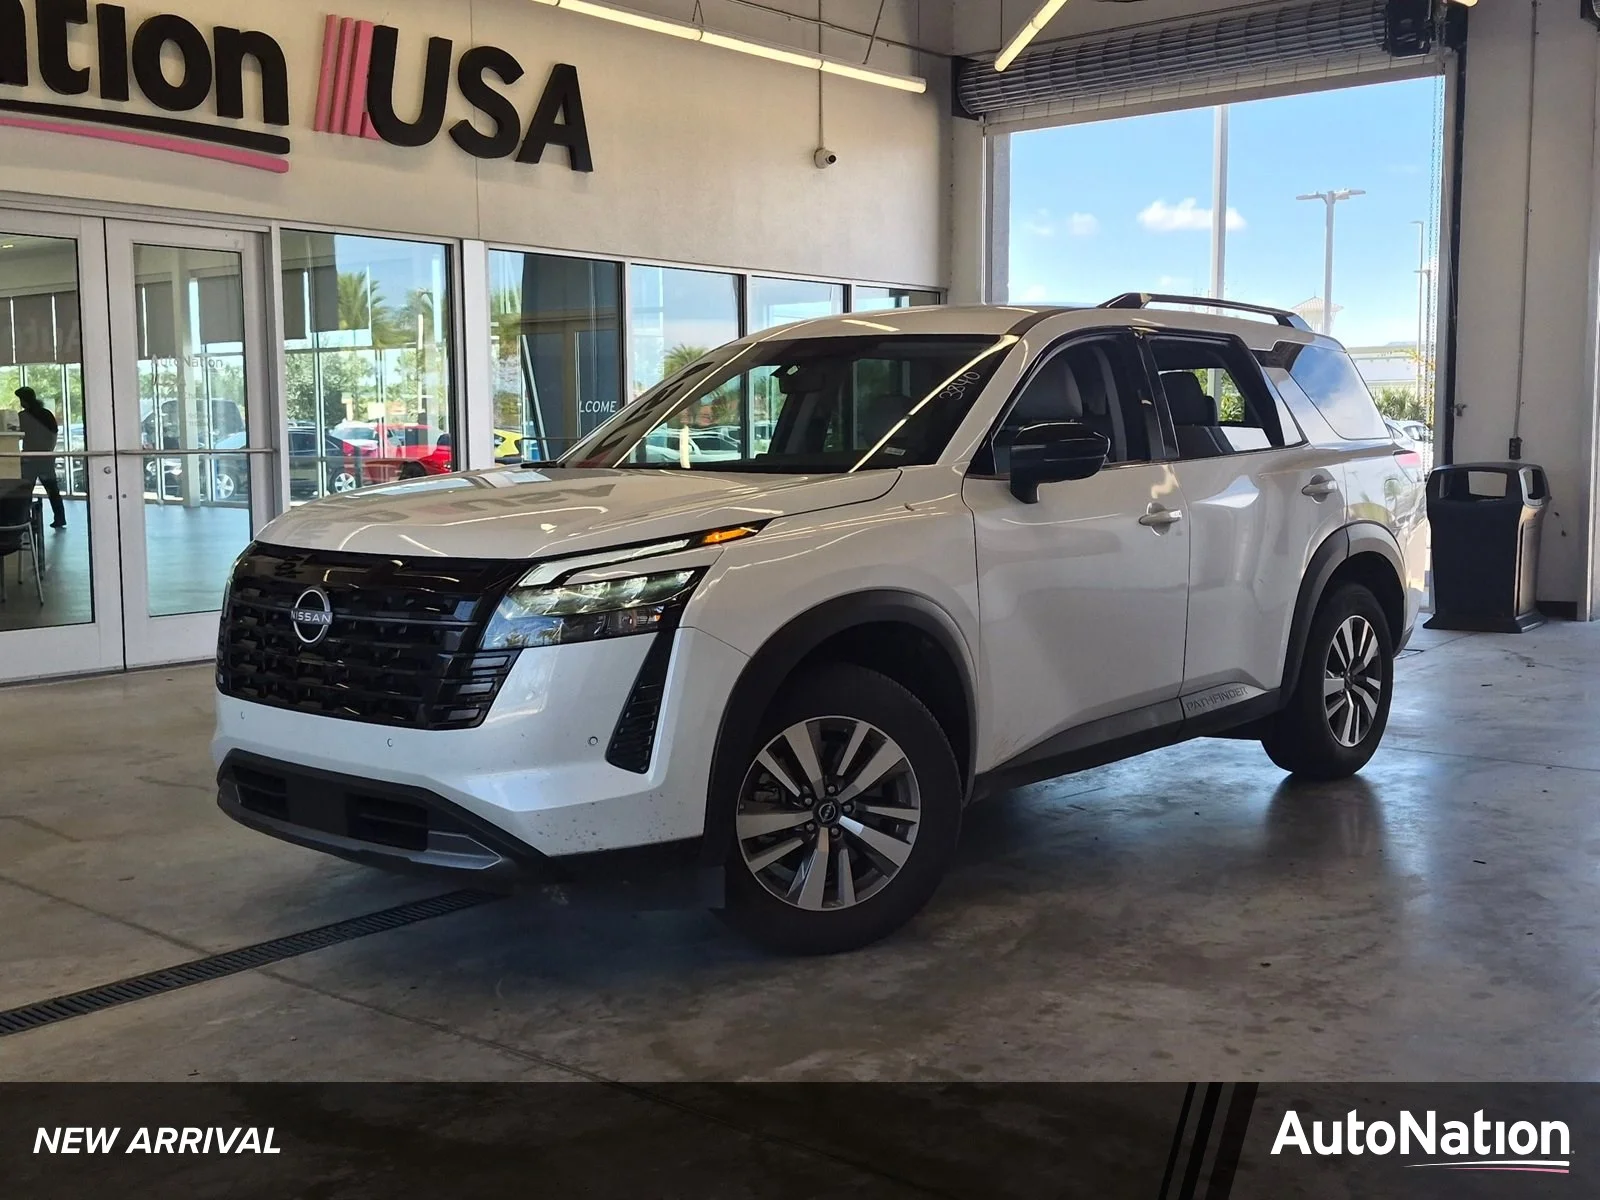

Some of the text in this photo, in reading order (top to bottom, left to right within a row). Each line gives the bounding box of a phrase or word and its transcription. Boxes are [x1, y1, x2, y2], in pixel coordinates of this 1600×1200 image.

[367, 25, 593, 172] USA
[150, 354, 223, 368] AutoNaton
[939, 371, 980, 400] 3840
[291, 609, 331, 623] NISSAN
[1185, 686, 1249, 711] PATHFINDER
